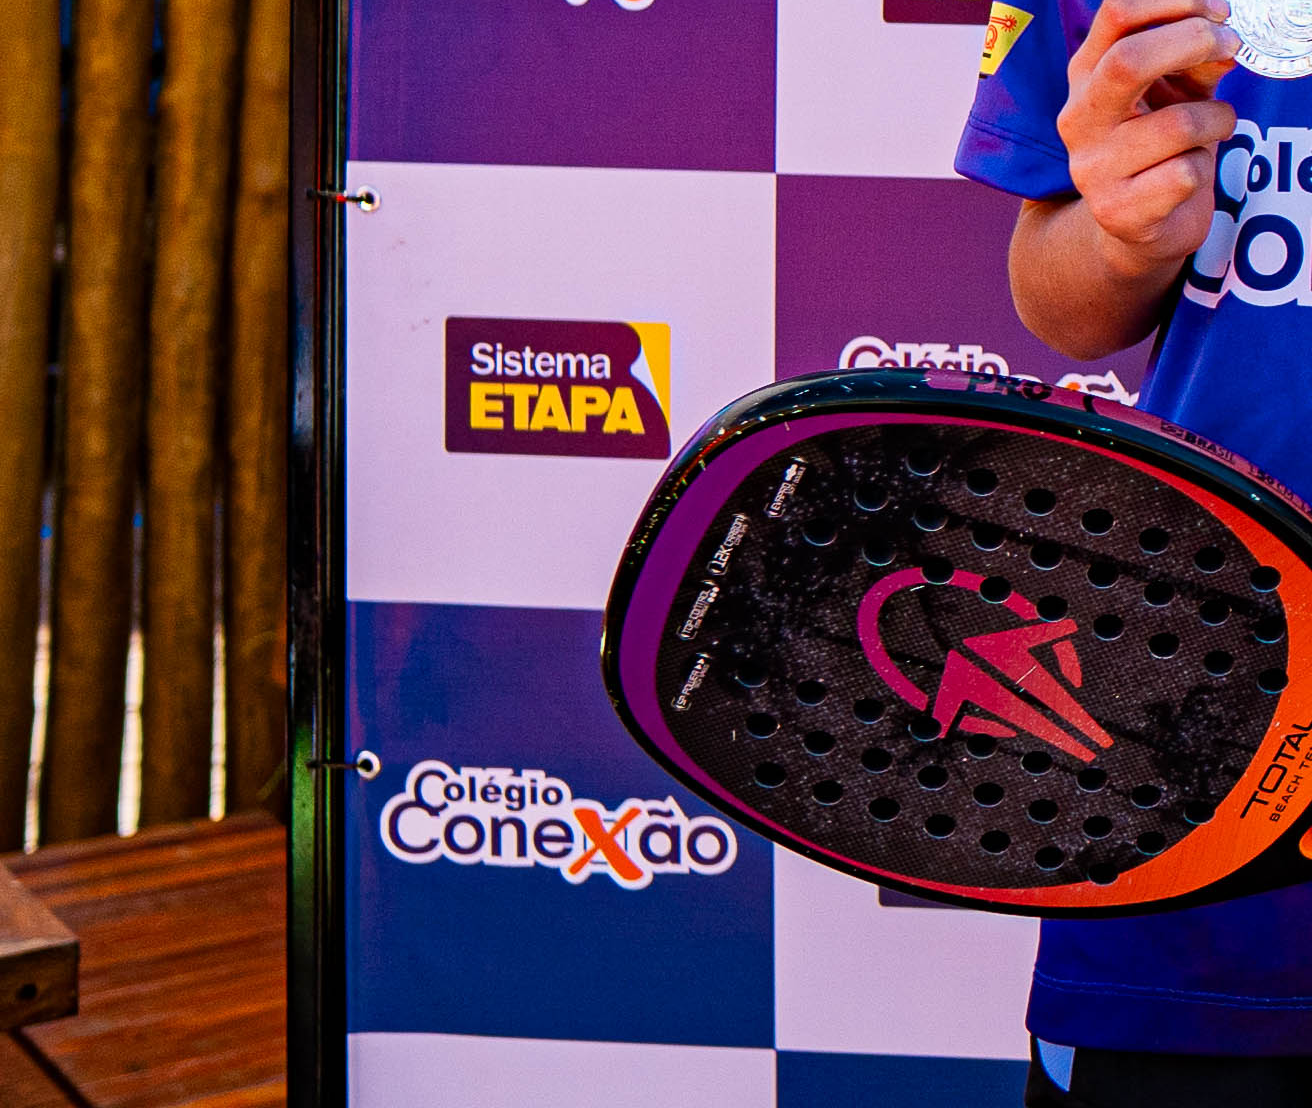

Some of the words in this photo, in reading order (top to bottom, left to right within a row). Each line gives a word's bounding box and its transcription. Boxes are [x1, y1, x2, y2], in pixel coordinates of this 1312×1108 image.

[471, 342, 611, 379] Sistema
[469, 383, 645, 435] ETAPA
[413, 769, 563, 813] Colégio
[1270, 775, 1303, 822] BEACH
